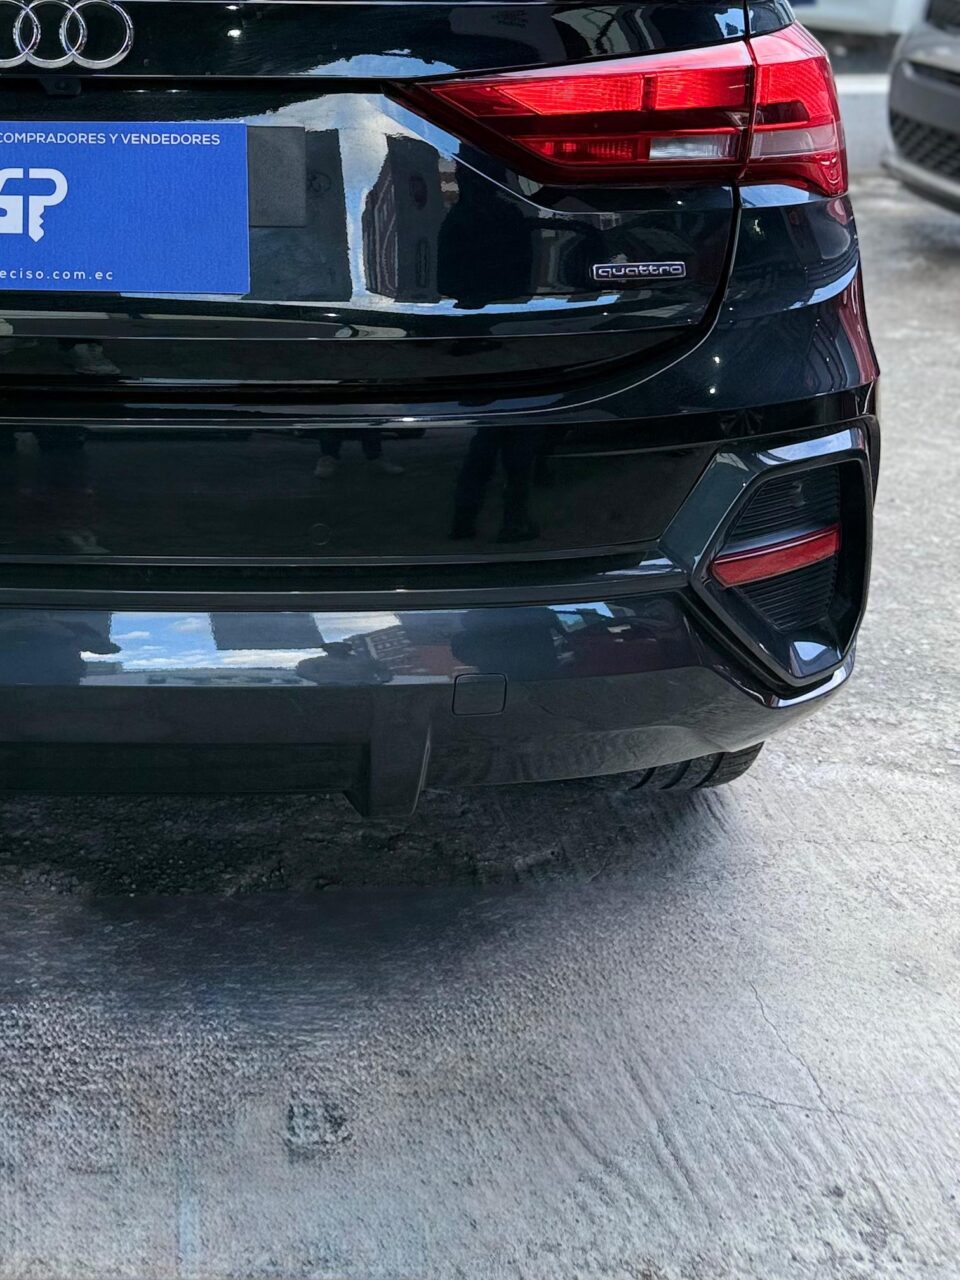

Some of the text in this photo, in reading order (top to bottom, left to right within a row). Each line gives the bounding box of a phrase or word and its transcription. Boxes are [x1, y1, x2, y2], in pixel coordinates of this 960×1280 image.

[109, 133, 119, 144] Y
[120, 133, 221, 145] VENDEDORES
[599, 265, 682, 278] quattro
